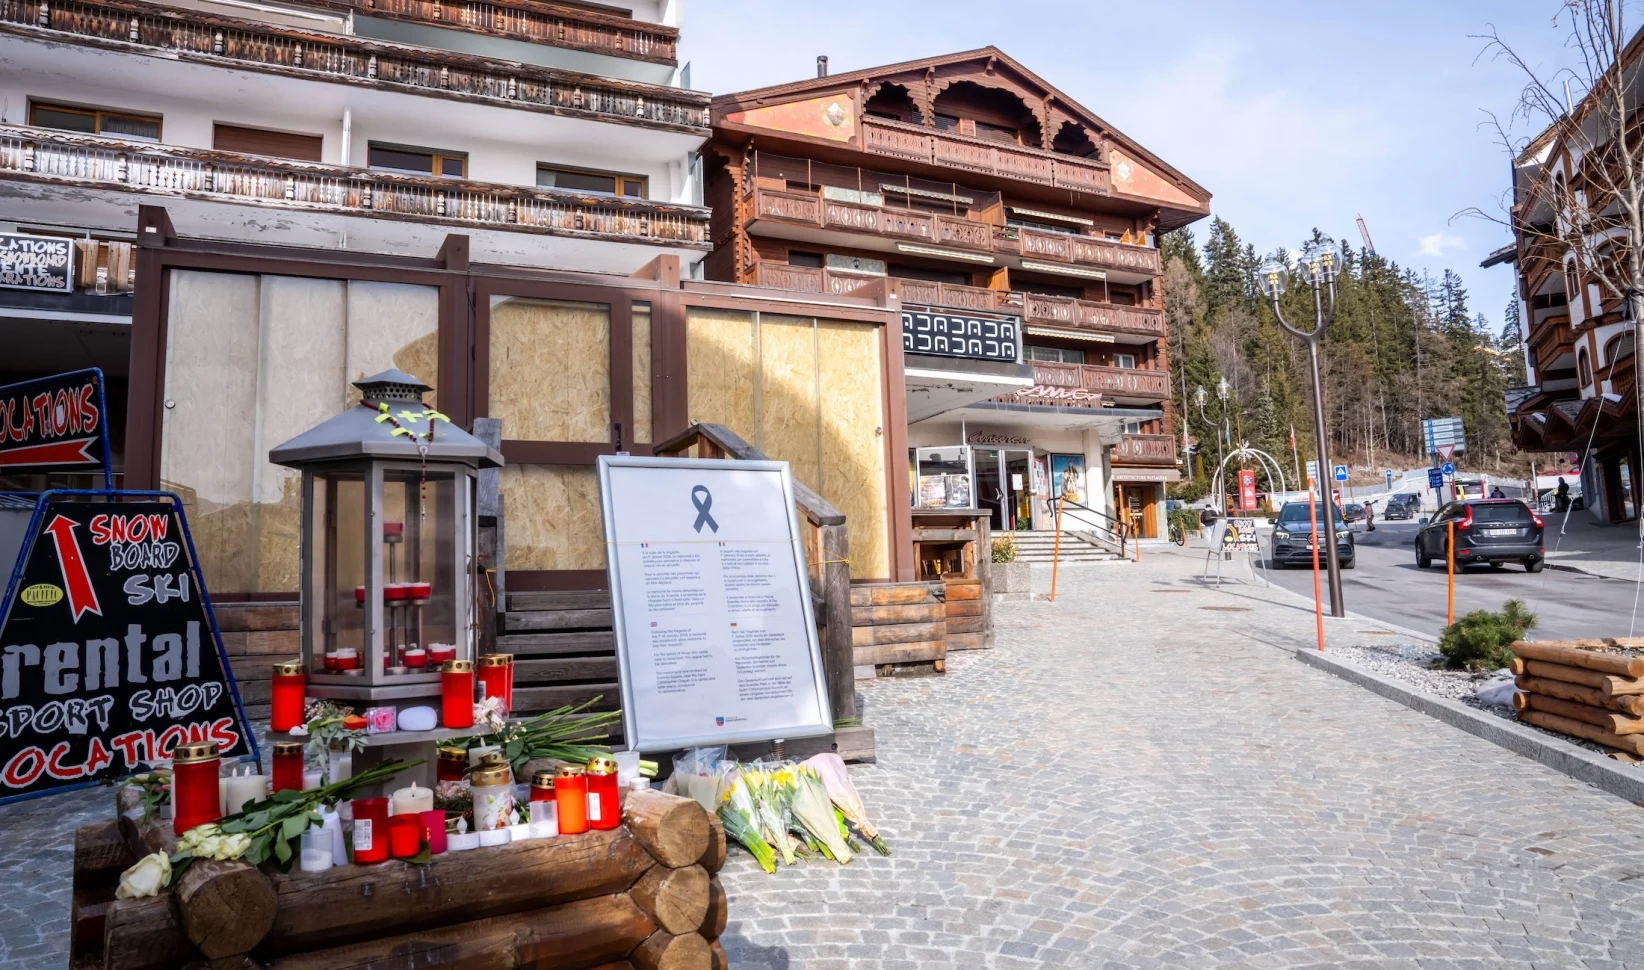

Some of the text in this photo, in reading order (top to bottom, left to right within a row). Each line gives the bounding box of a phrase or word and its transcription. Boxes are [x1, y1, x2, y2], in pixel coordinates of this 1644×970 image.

[0, 383, 98, 443] OCATIONS
[90, 513, 168, 545] SNOW
[110, 542, 179, 570] BOARD
[123, 573, 189, 605] SKI
[1, 621, 200, 699] rental
[129, 682, 222, 721] SHOP
